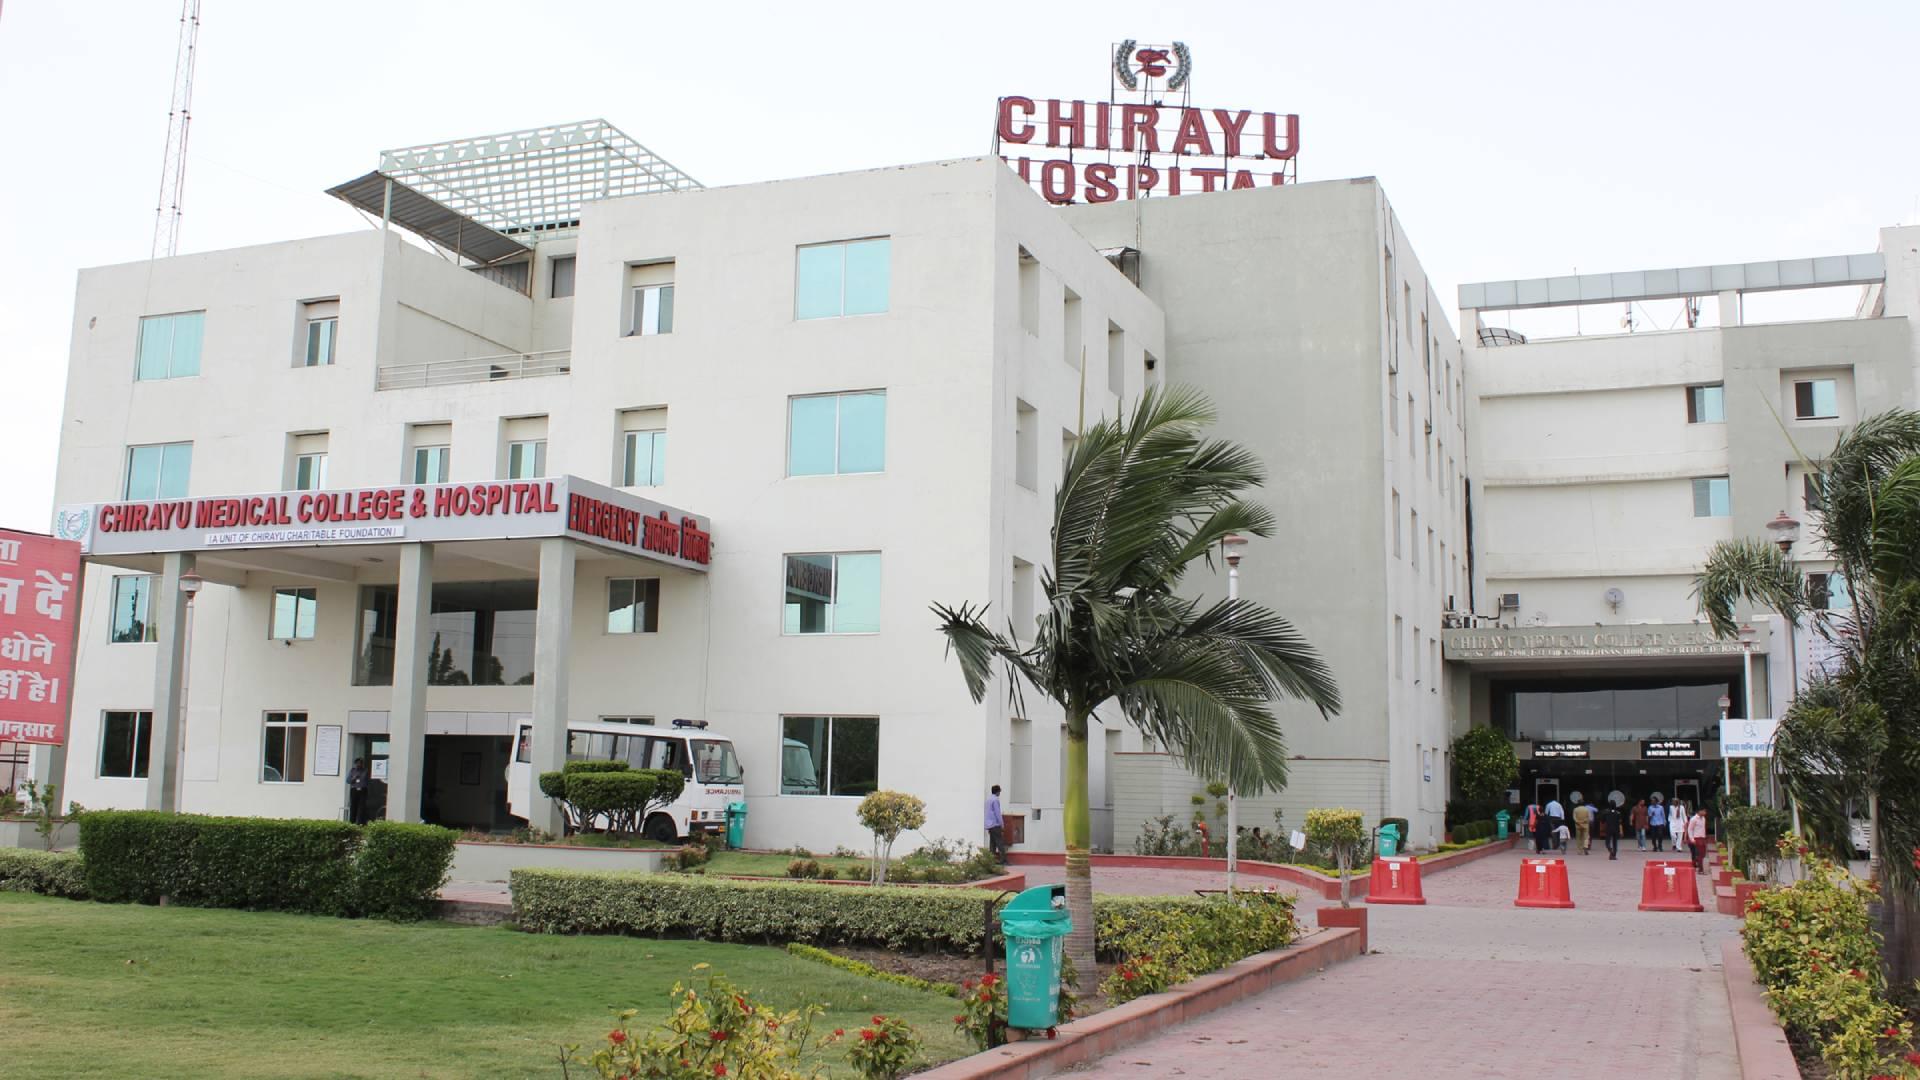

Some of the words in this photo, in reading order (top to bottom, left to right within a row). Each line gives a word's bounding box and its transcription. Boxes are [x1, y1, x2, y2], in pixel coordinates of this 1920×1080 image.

[999, 95, 1300, 160] CHIRAYU
[100, 501, 193, 533] CHIRAYU
[195, 495, 291, 528] MEDICAL
[297, 489, 405, 523] COLLEGE
[410, 488, 427, 518] &
[434, 482, 559, 518] HOSPITAL
[568, 492, 640, 546] EMERGENCY
[252, 532, 285, 541] CHIRAYU
[287, 530, 336, 540] CHARITABLE
